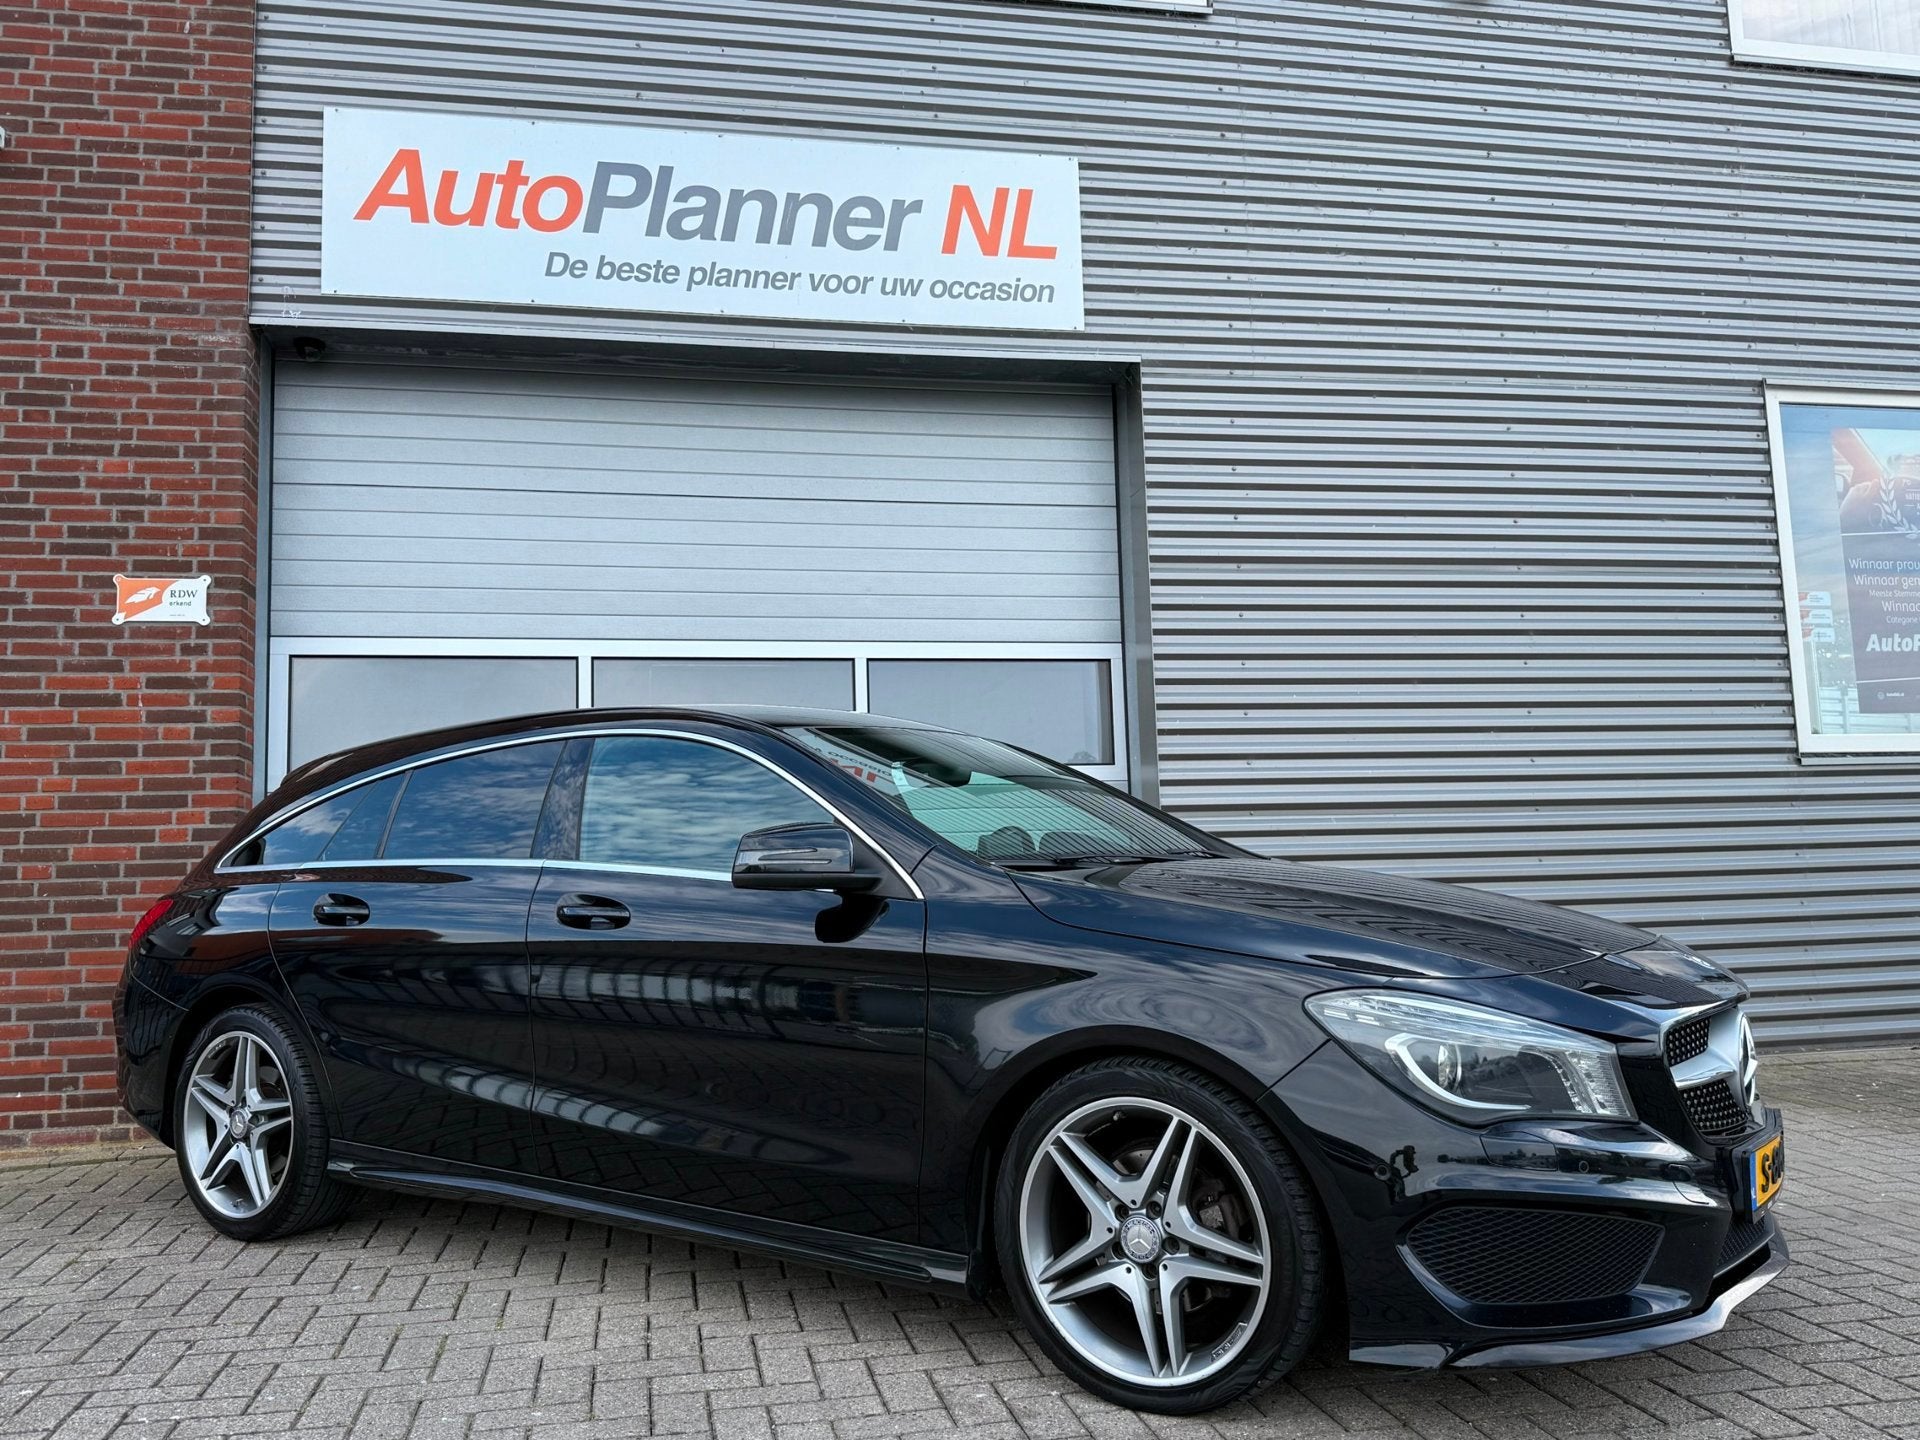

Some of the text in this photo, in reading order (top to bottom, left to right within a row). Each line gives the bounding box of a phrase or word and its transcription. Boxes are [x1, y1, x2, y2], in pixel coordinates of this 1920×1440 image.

[353, 148, 1057, 259] AutoPlanner NL
[545, 251, 1055, 303] De beste planner voor uw occasion
[1848, 557, 1894, 569] Winnaar
[1853, 574, 1899, 586] Winnaar
[170, 589, 198, 598] RDW
